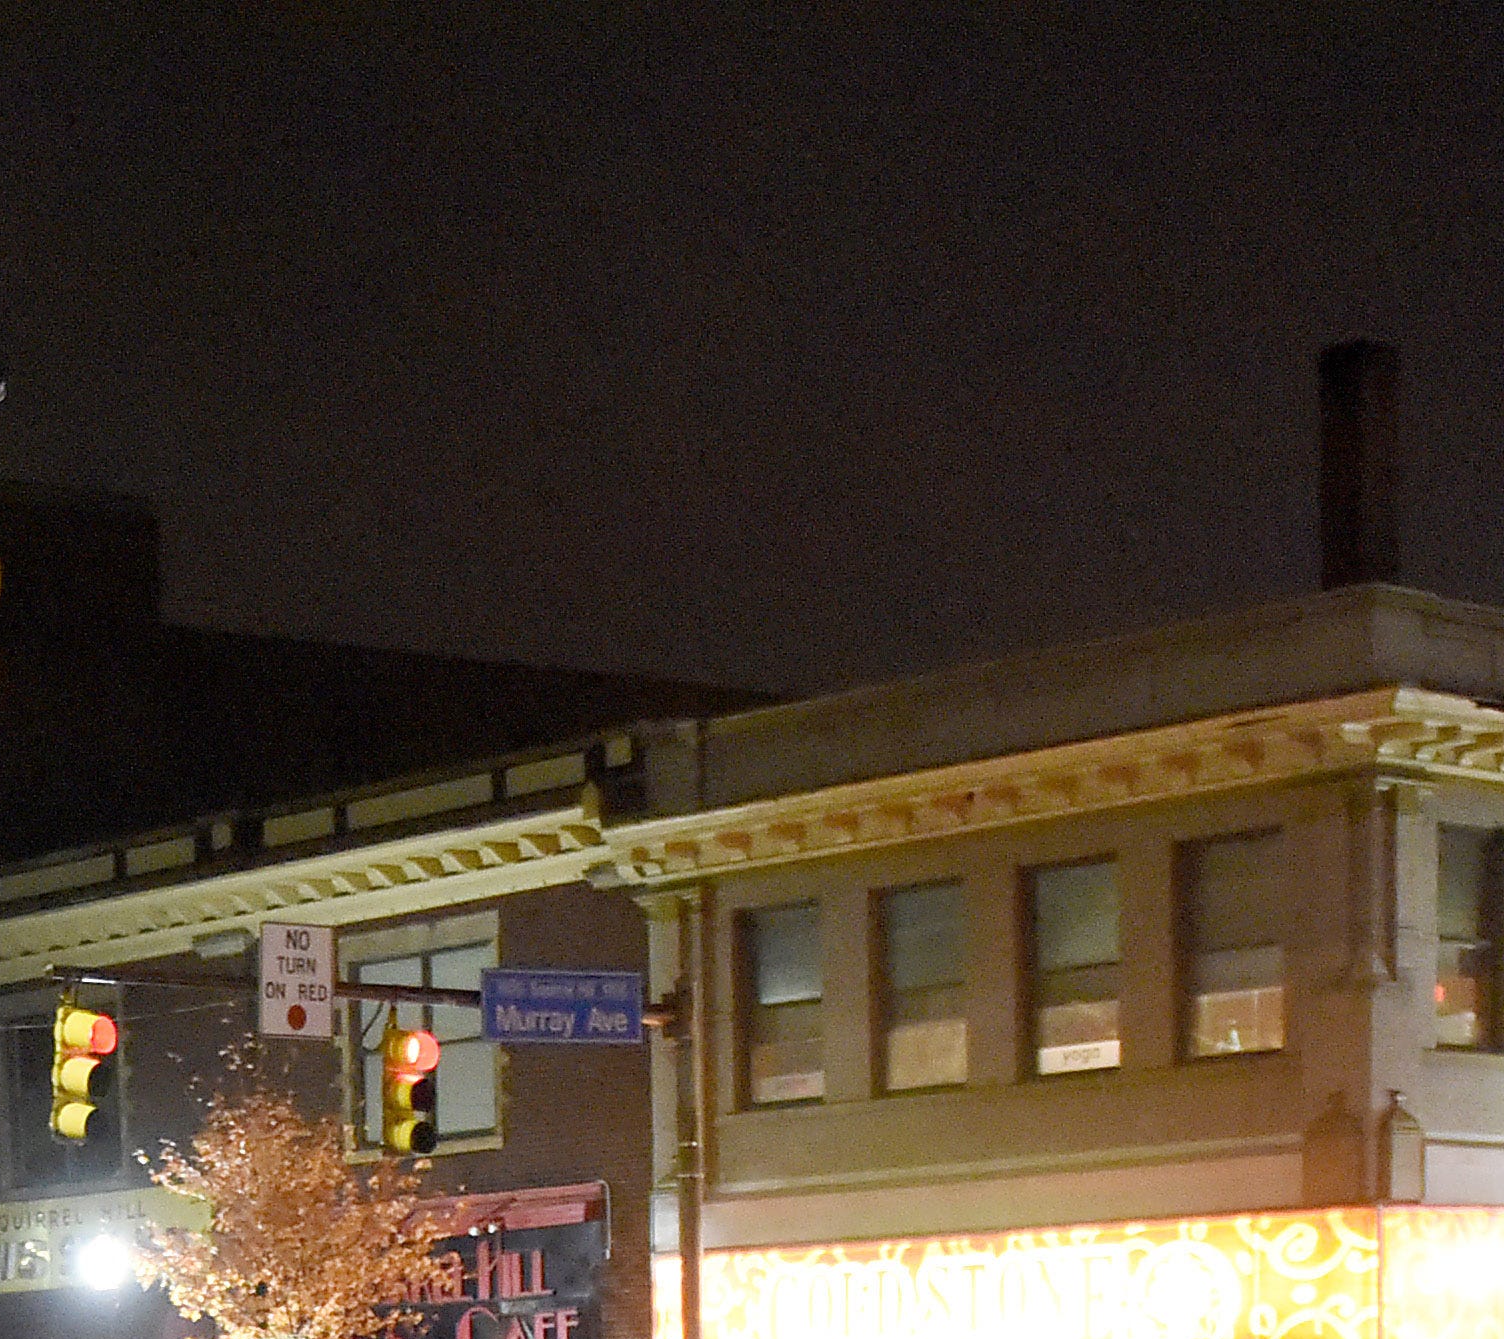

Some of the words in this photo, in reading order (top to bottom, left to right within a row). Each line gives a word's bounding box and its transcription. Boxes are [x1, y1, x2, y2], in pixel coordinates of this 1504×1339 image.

[286, 930, 310, 950] NO
[277, 955, 317, 975] TURN
[266, 982, 286, 999] ON
[298, 984, 328, 1001] RED
[495, 1004, 574, 1037] Murray
[588, 1007, 628, 1032] Ave
